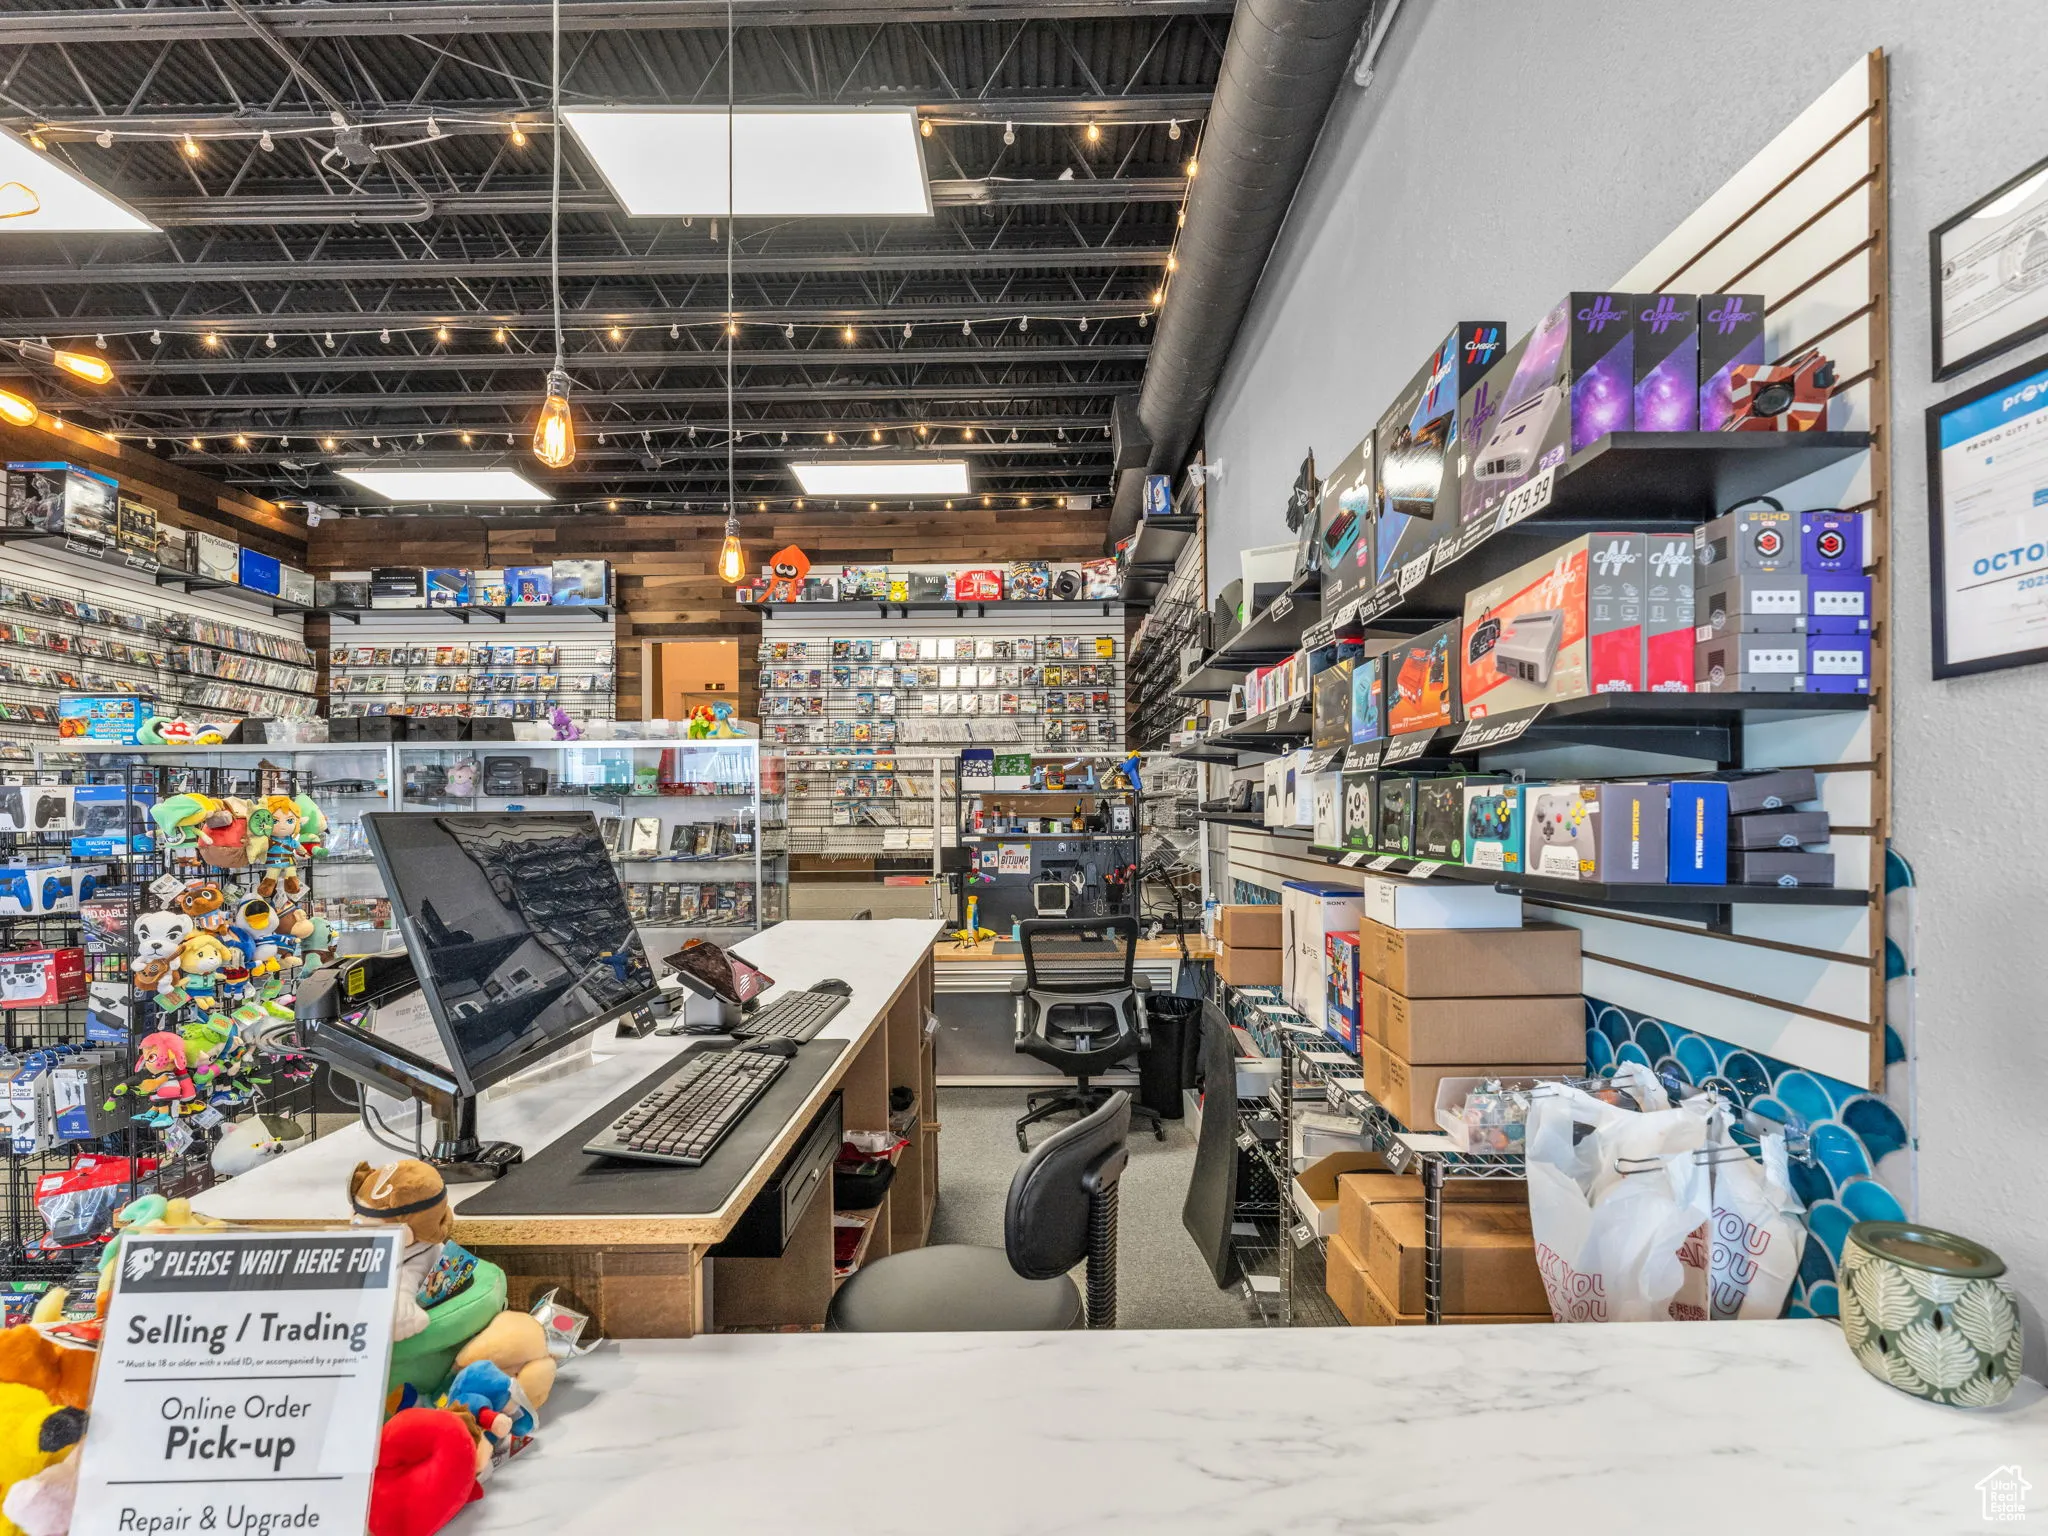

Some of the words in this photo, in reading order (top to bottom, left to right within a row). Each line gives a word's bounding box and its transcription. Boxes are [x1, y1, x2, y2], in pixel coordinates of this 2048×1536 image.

[1505, 476, 1550, 522] $79.99
[201, 534, 236, 551] PlayStation
[1973, 543, 2048, 577] OCTO
[972, 573, 986, 581] Wii
[1001, 855, 1029, 865] BITJUMP
[1296, 1225, 1311, 1241] PS3
[161, 1250, 235, 1276] PLEASE
[238, 1249, 290, 1275] WAIT
[292, 1248, 346, 1274] HERE
[346, 1247, 386, 1273] FOR
[127, 1314, 228, 1355] Selling
[235, 1312, 252, 1342] /
[260, 1311, 368, 1352] Trading
[126, 1359, 146, 1368] Must
[147, 1359, 156, 1368] be
[158, 1358, 167, 1367] 18
[178, 1358, 197, 1367] older
[199, 1358, 215, 1367] with
[223, 1358, 241, 1366] valid
[265, 1357, 314, 1368] accompanied
[316, 1357, 324, 1368] by
[333, 1357, 359, 1368] parent.
[161, 1396, 236, 1420] Online
[245, 1394, 312, 1419] Order
[165, 1424, 296, 1472] Pick-up
[118, 1506, 192, 1536] Repair
[199, 1505, 217, 1530] &
[227, 1504, 320, 1536] Upgrade
